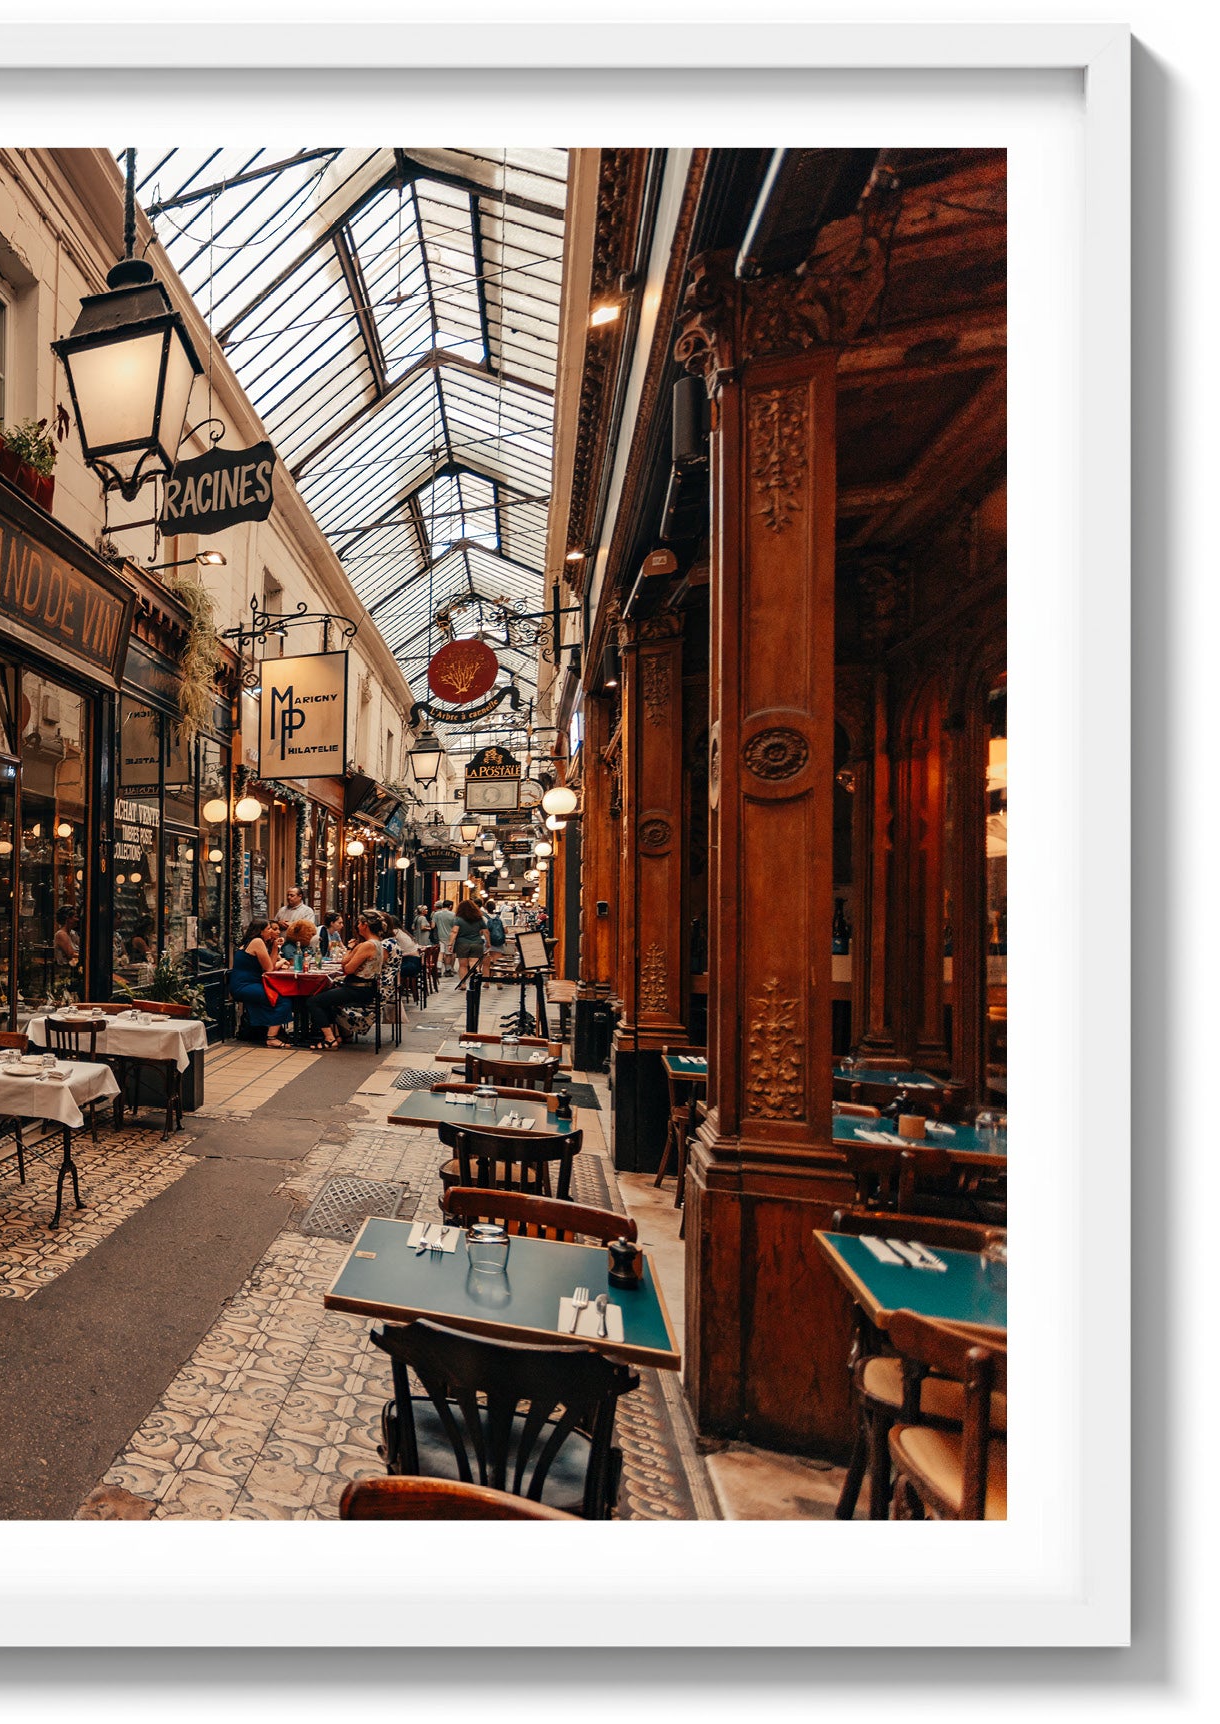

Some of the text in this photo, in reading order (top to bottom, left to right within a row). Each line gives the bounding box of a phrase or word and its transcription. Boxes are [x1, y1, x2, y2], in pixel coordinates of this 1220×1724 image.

[163, 460, 272, 521] RACINES
[44, 565, 82, 636] DE
[82, 588, 119, 660] VIN
[429, 706, 458, 721] L'Arbre
[460, 712, 467, 720] à
[465, 767, 478, 778] LA
[479, 765, 521, 777] POSTALE
[115, 798, 160, 828] ACHAT VENTE
[140, 827, 153, 845] POSTE
